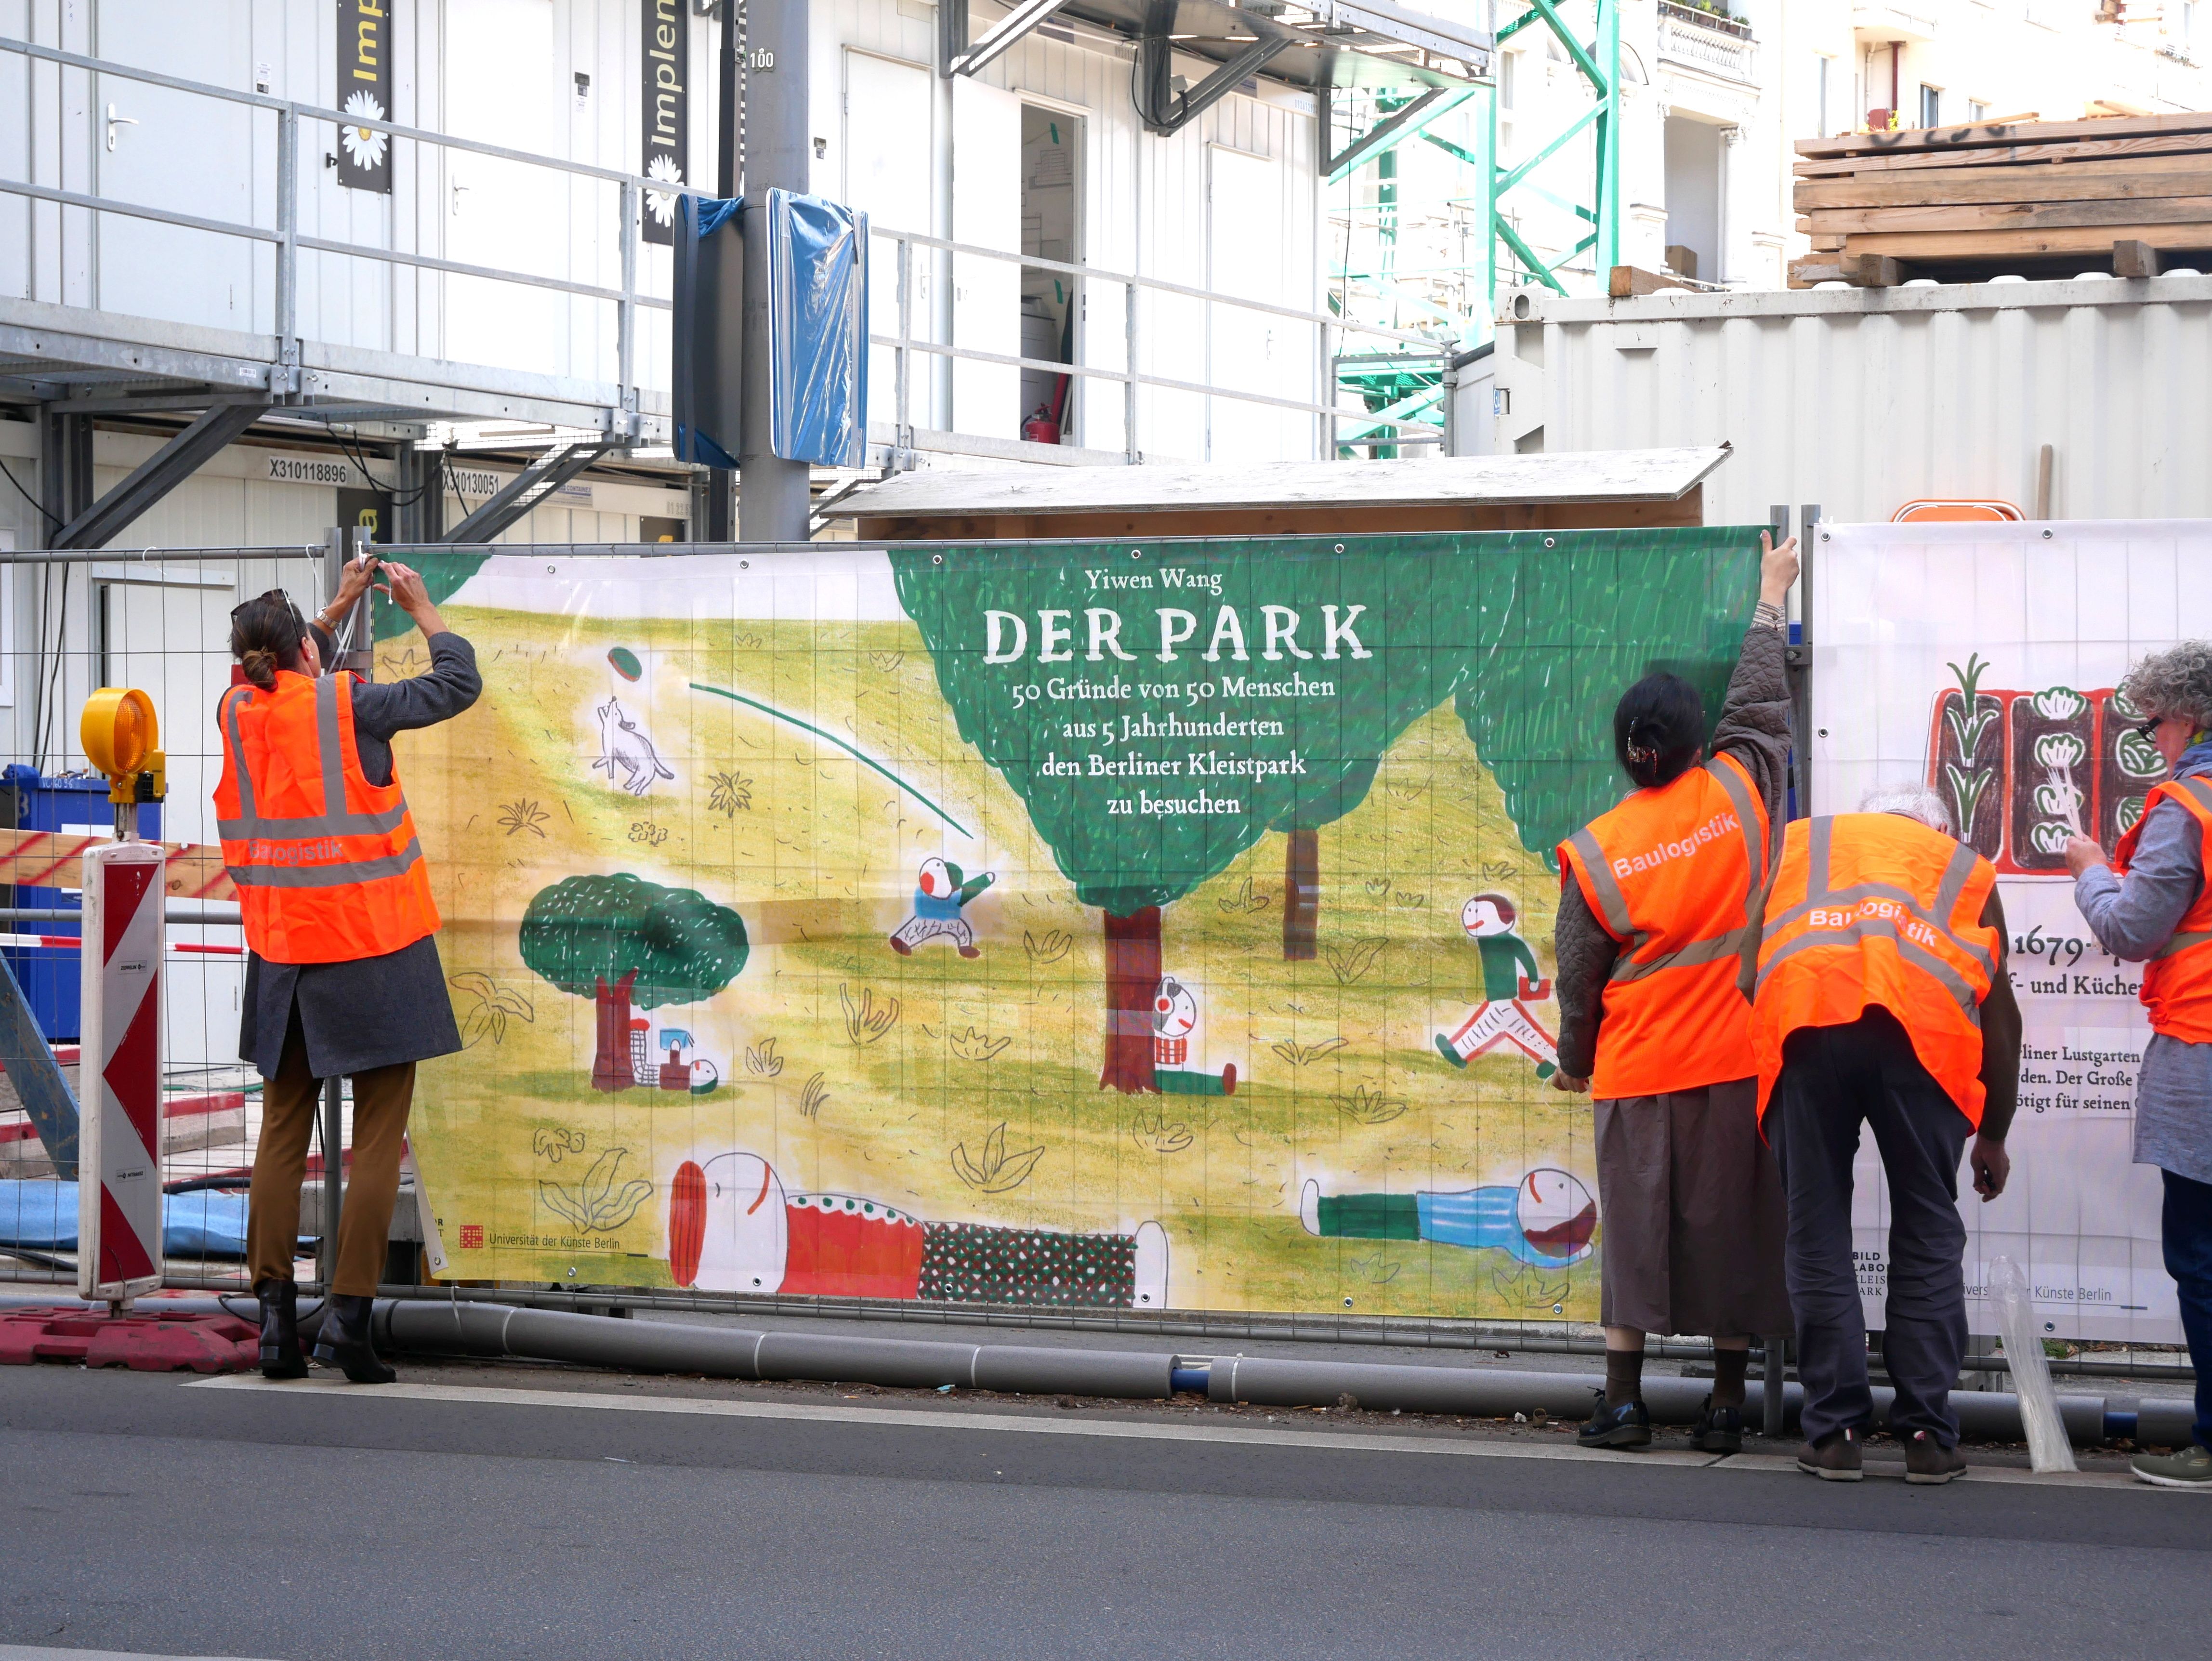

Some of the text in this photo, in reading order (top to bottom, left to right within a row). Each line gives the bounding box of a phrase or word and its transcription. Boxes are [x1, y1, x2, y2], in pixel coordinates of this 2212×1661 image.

[750, 53, 774, 68] 100
[270, 459, 346, 482] X310118896
[443, 470, 499, 495] X310130051
[1085, 568, 1223, 595] Yiwen Wang
[983, 604, 1373, 664] DER PARK
[1013, 672, 1336, 709] 50 Gründe von 50 Menschen
[1063, 712, 1284, 746] aus 5 Jahrhunderten
[1042, 750, 1306, 783] den Berliner Kleistpark
[1107, 789, 1240, 814] zu besuchen
[1612, 812, 1739, 879] Baulogistik
[2030, 974, 2067, 994] und
[2020, 1043, 2141, 1067] liner Lustgarten
[2019, 1068, 2052, 1084] den.
[2055, 1070, 2083, 1085] Der
[2087, 1071, 2133, 1086] Große
[2055, 1093, 2079, 1108] für
[2083, 1094, 2131, 1110] seinen
[489, 1233, 620, 1249] Universität der Künste Berlin
[1853, 1252, 1880, 1260] BILD
[1854, 1263, 1889, 1272] LABO
[2035, 1286, 2074, 1300] Künste
[2079, 1287, 2111, 1301] Berlin
